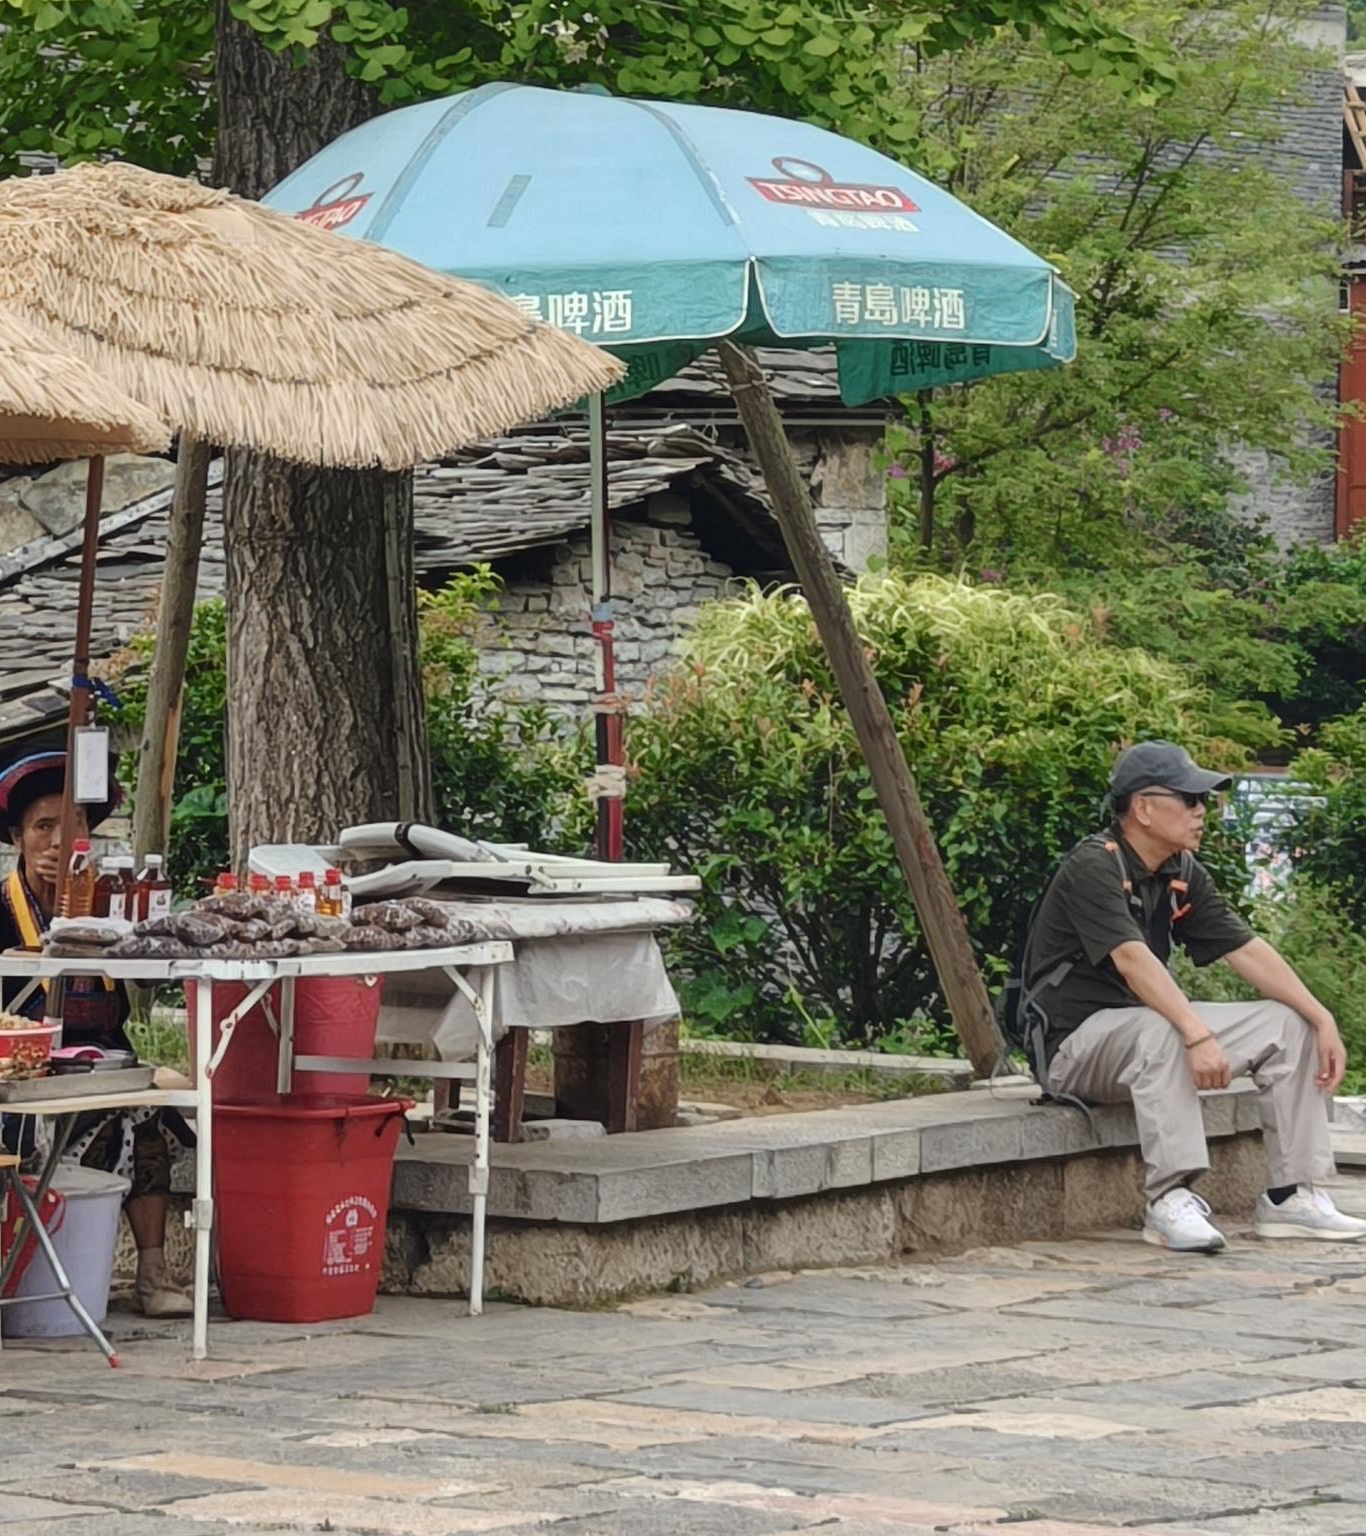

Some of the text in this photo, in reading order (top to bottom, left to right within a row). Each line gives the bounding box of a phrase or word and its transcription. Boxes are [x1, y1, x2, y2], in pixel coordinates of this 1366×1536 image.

[757, 181, 904, 209] TSINGTAO
[832, 281, 965, 330] 青島啤酒
